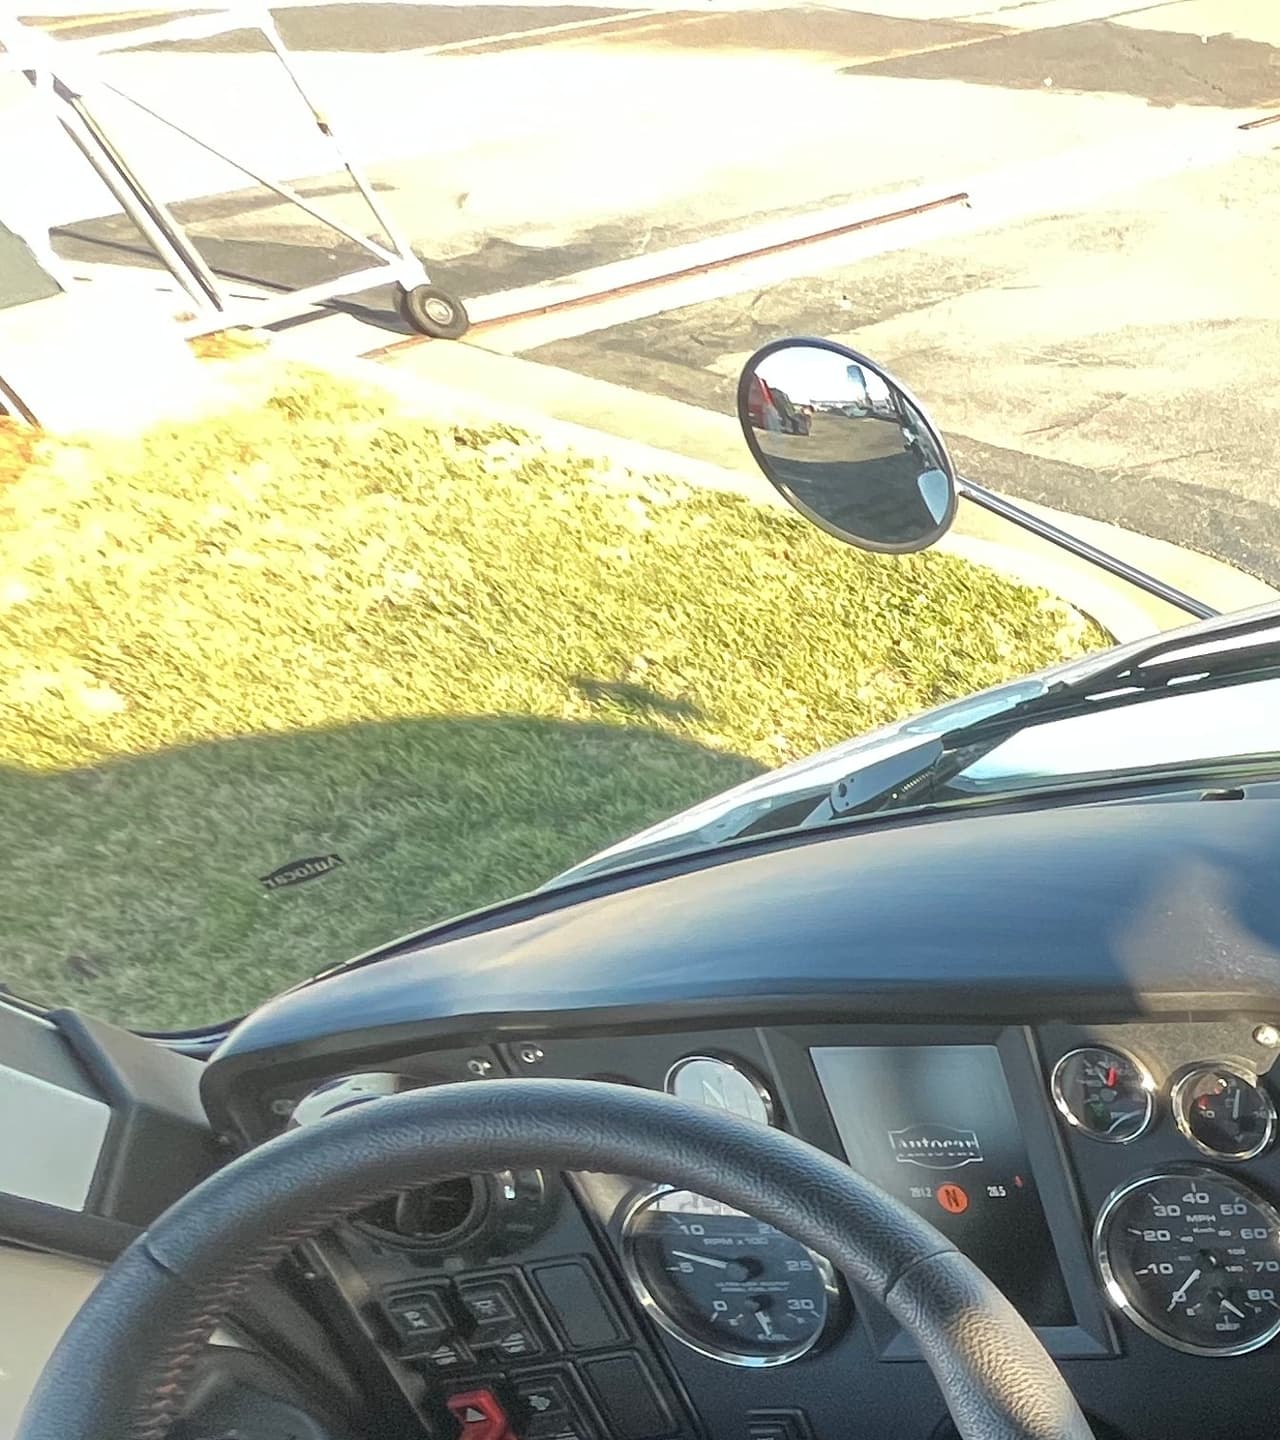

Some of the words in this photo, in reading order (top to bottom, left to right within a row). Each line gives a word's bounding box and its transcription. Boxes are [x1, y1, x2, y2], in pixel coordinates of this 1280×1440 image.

[1182, 1192, 1209, 1204] 40
[1153, 1205, 1181, 1217] 30
[1220, 1203, 1247, 1216] 50
[1185, 1214, 1216, 1223] MPH
[679, 1225, 705, 1236] 10
[1143, 1229, 1171, 1242] 20
[1240, 1228, 1268, 1240] 60
[680, 1262, 694, 1273] 5
[785, 1260, 813, 1272] 25
[1147, 1263, 1174, 1275] 10
[1252, 1261, 1279, 1272] 70
[1247, 1289, 1275, 1301] 80
[713, 1300, 728, 1312] 0
[787, 1299, 815, 1311] 30
